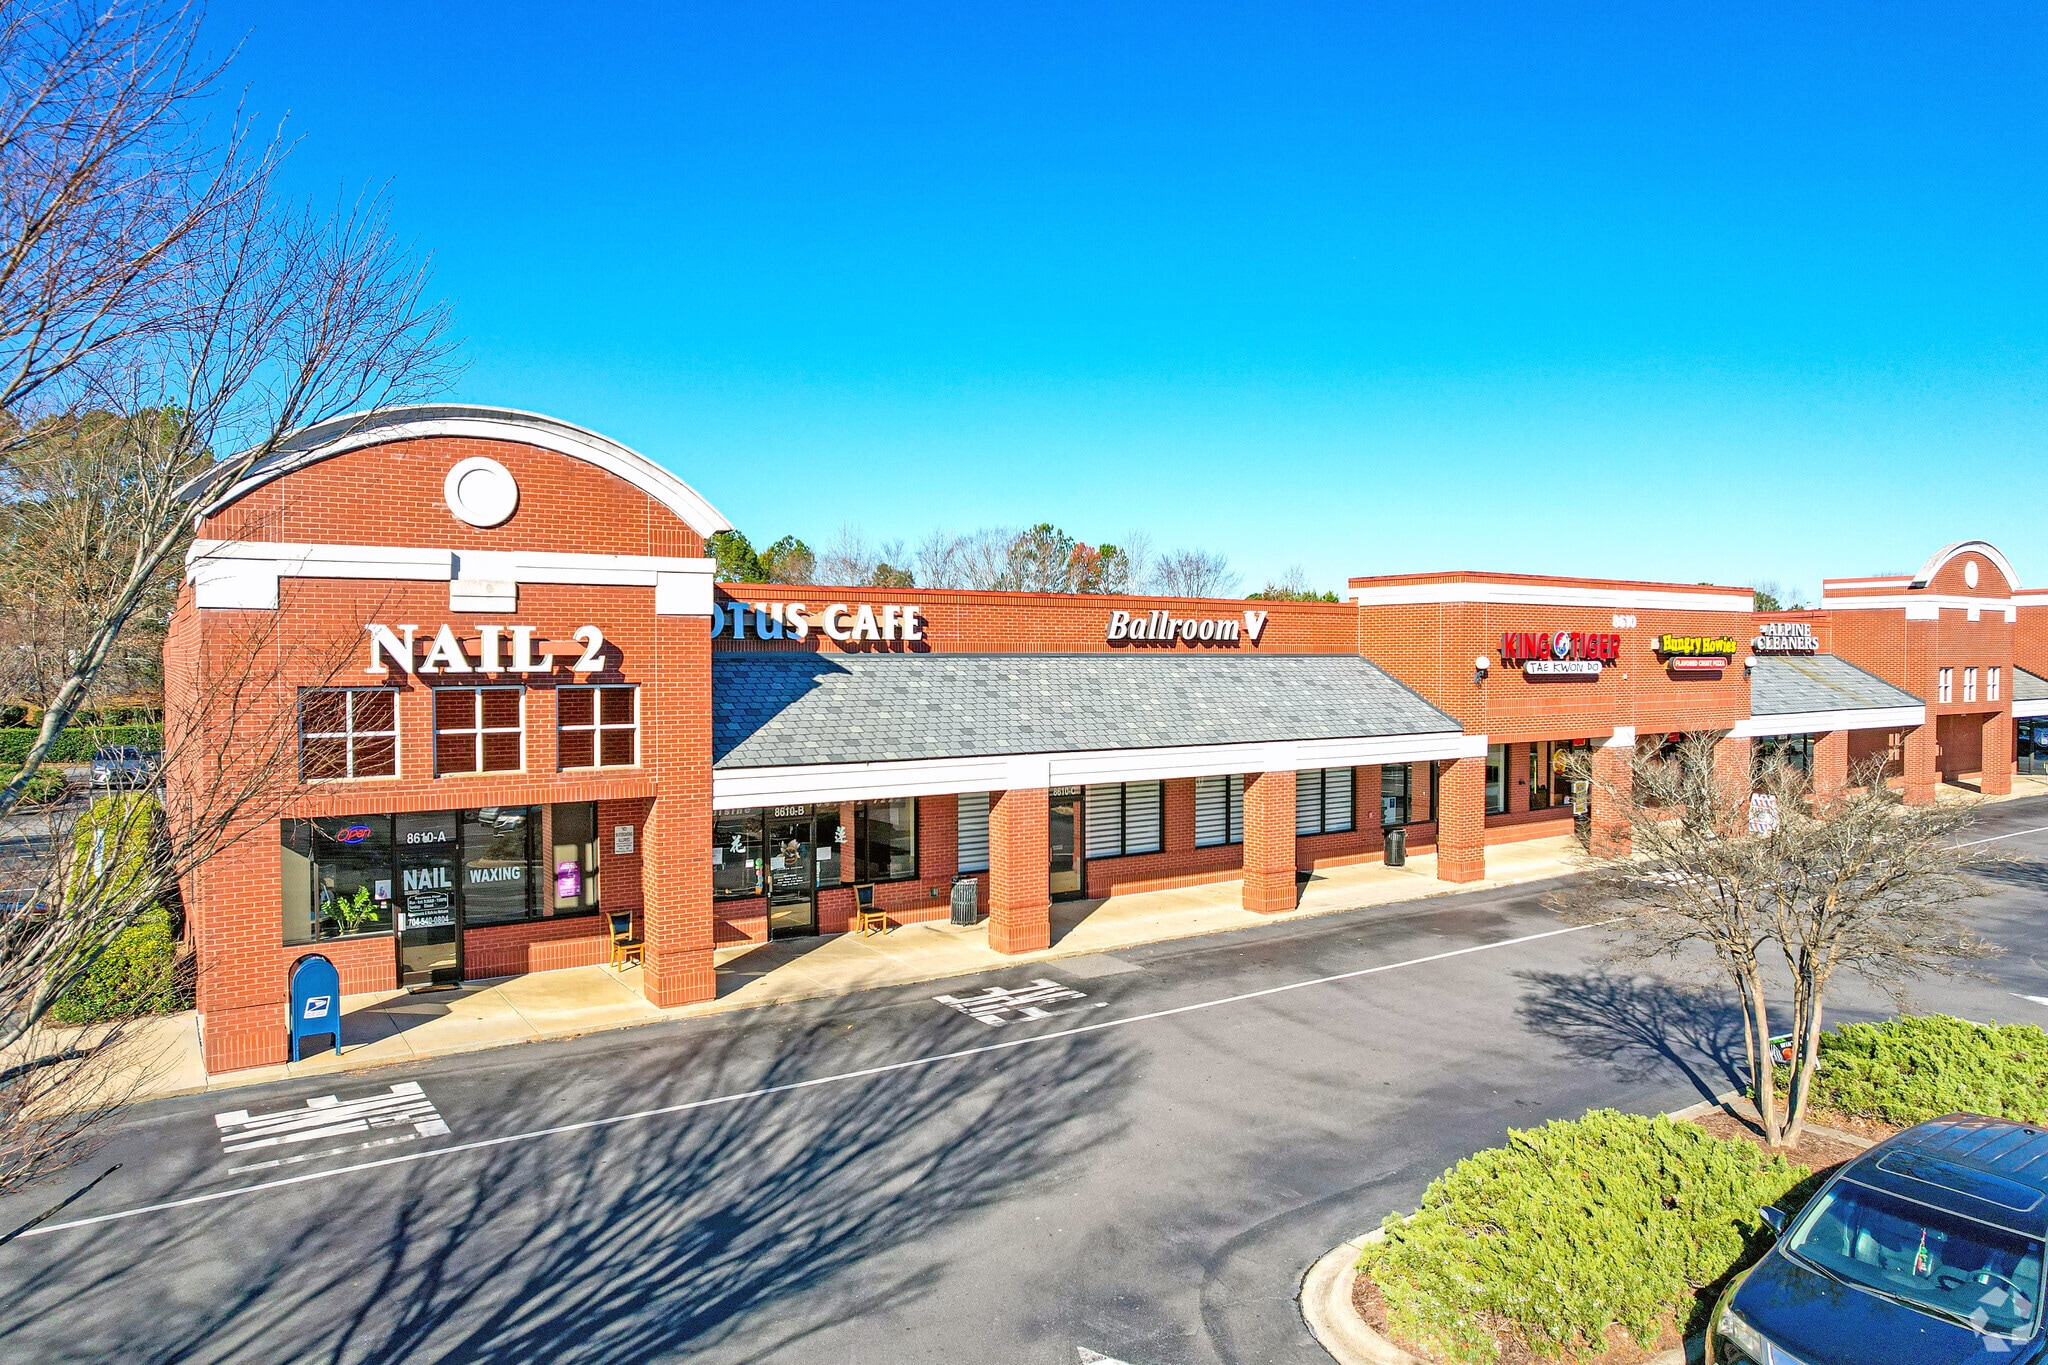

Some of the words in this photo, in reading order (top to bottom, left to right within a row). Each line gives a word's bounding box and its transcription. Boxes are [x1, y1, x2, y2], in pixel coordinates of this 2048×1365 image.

[822, 603, 922, 640] CAFE
[1107, 610, 1239, 641] Ballroom
[1242, 610, 1268, 640] V
[1766, 623, 1812, 637] ALPINE
[364, 623, 553, 674] NAIL
[572, 625, 606, 672] 2
[1502, 632, 1550, 660] KING
[1570, 632, 1621, 659] TIGER
[1662, 633, 1702, 655] Hungry
[1702, 636, 1738, 654] Howie's
[1756, 636, 1819, 651] CLEANERS
[1530, 662, 1549, 673] TAE
[1553, 662, 1584, 672] KWON
[1587, 662, 1599, 671] DO
[774, 805, 805, 817] 8610-B
[337, 828, 371, 843] Open
[729, 834, 746, 853] 花
[403, 867, 452, 891] NAIL
[469, 866, 521, 883] WAXING
